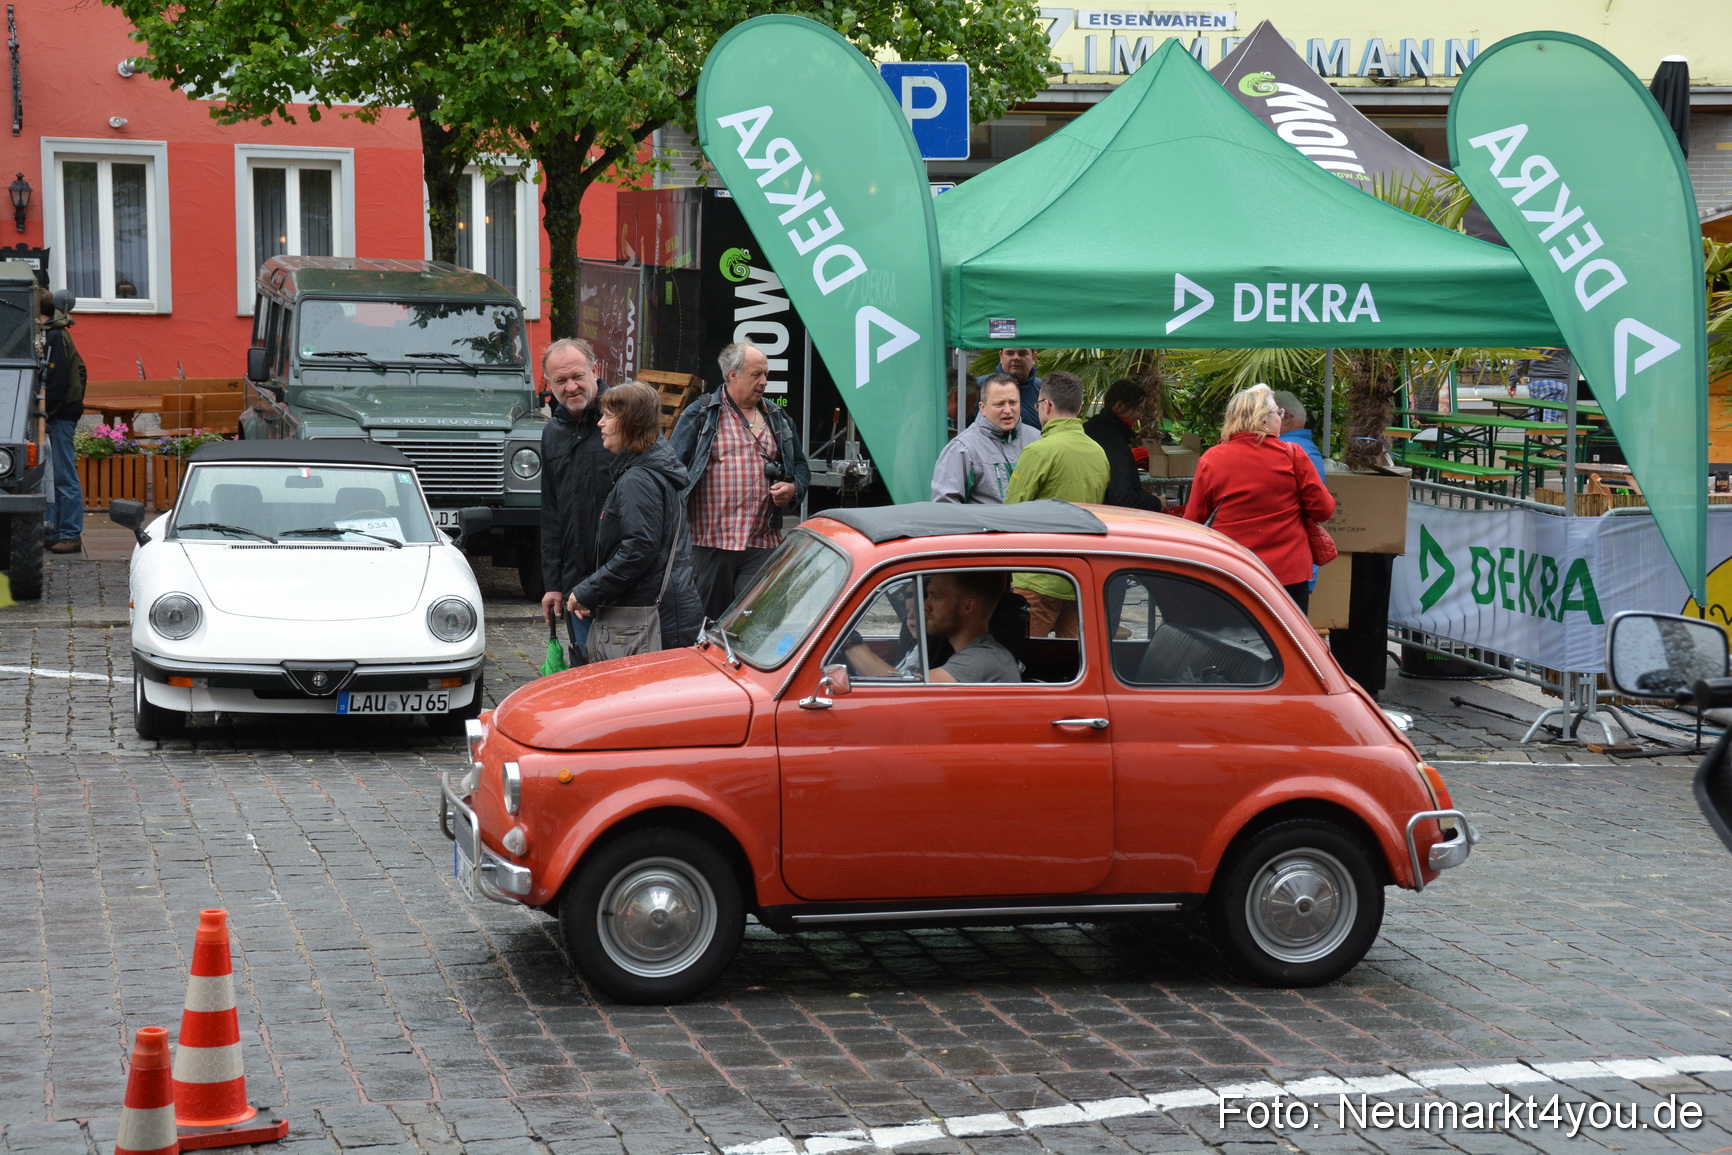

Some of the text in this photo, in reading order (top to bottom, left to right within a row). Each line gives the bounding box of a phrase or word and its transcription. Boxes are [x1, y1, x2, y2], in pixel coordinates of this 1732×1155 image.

[1089, 13, 1227, 27] EISENWAREN
[902, 76, 947, 131] P
[1233, 282, 1381, 323] DEKRA
[367, 521, 388, 530] 534
[1469, 546, 1605, 625] DEKRA
[349, 694, 387, 712] LAU
